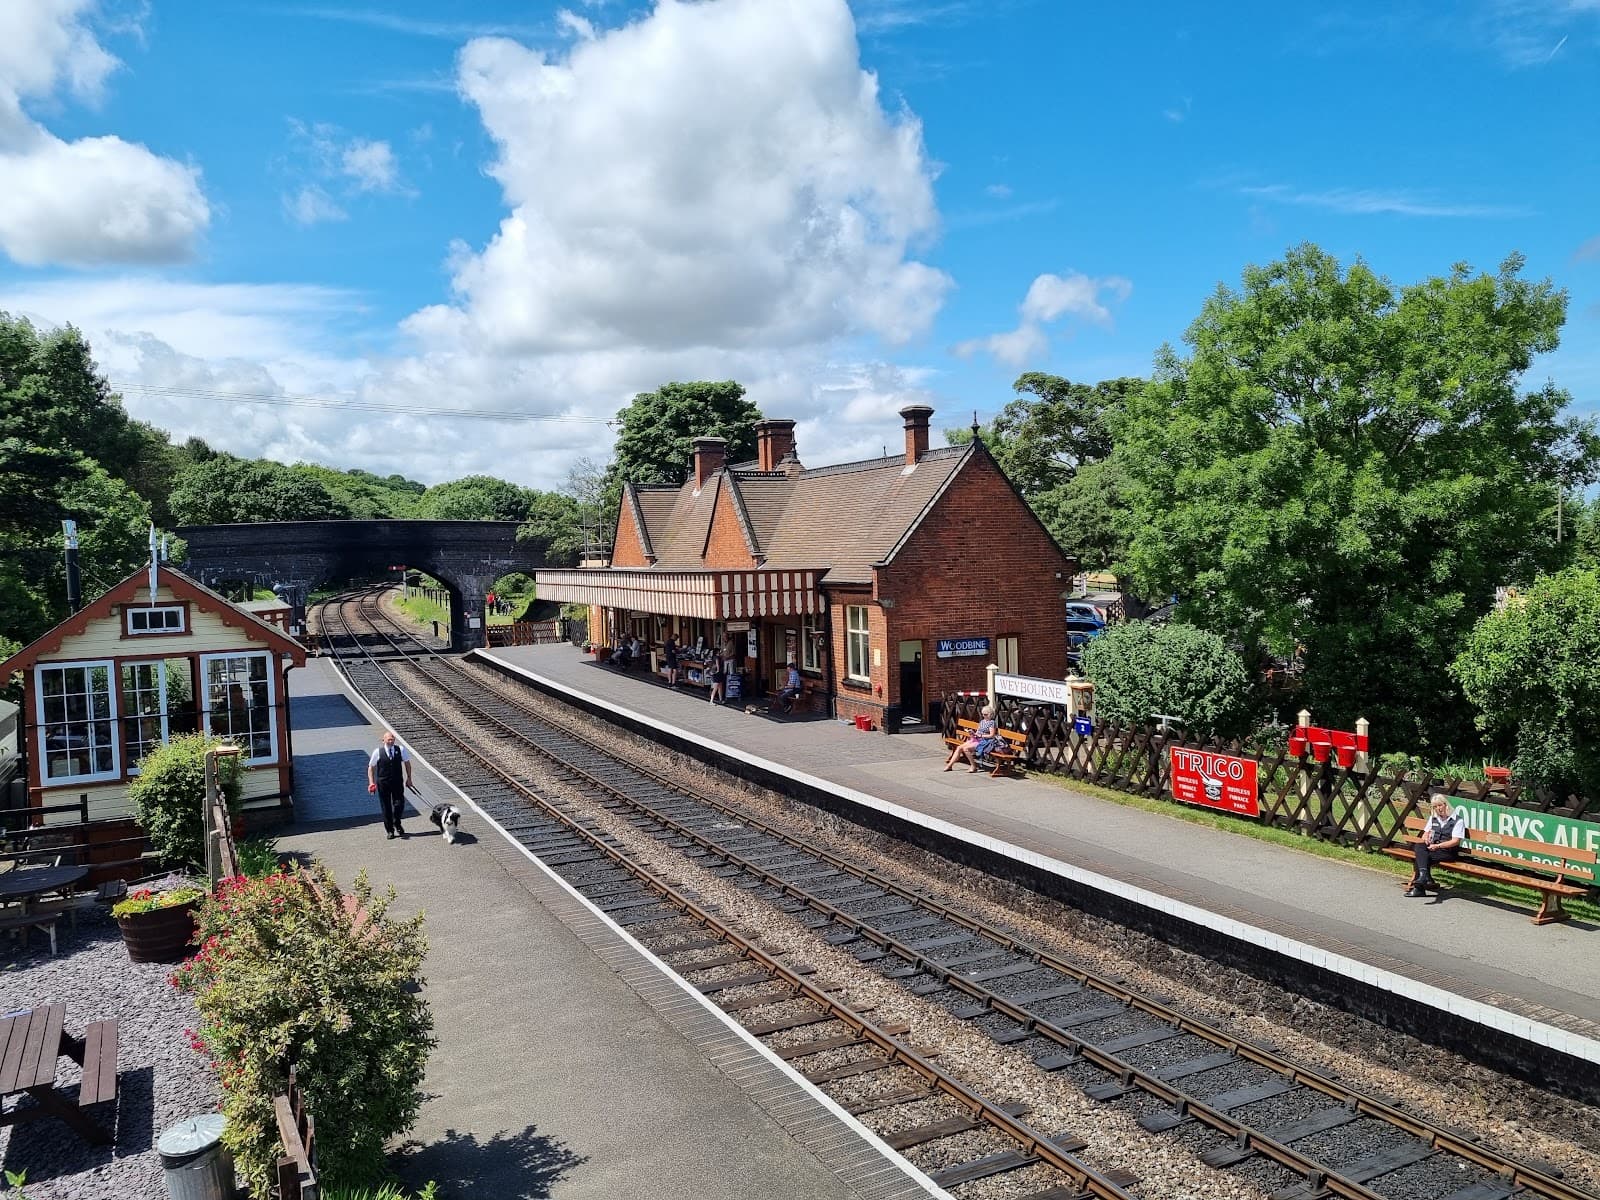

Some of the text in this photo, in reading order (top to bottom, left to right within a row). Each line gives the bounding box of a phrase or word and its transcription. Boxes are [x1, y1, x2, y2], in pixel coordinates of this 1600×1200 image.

[940, 640, 986, 651] WOODBINE
[1000, 680, 1062, 699] WEYBOURNE
[1175, 751, 1243, 781] TRICO
